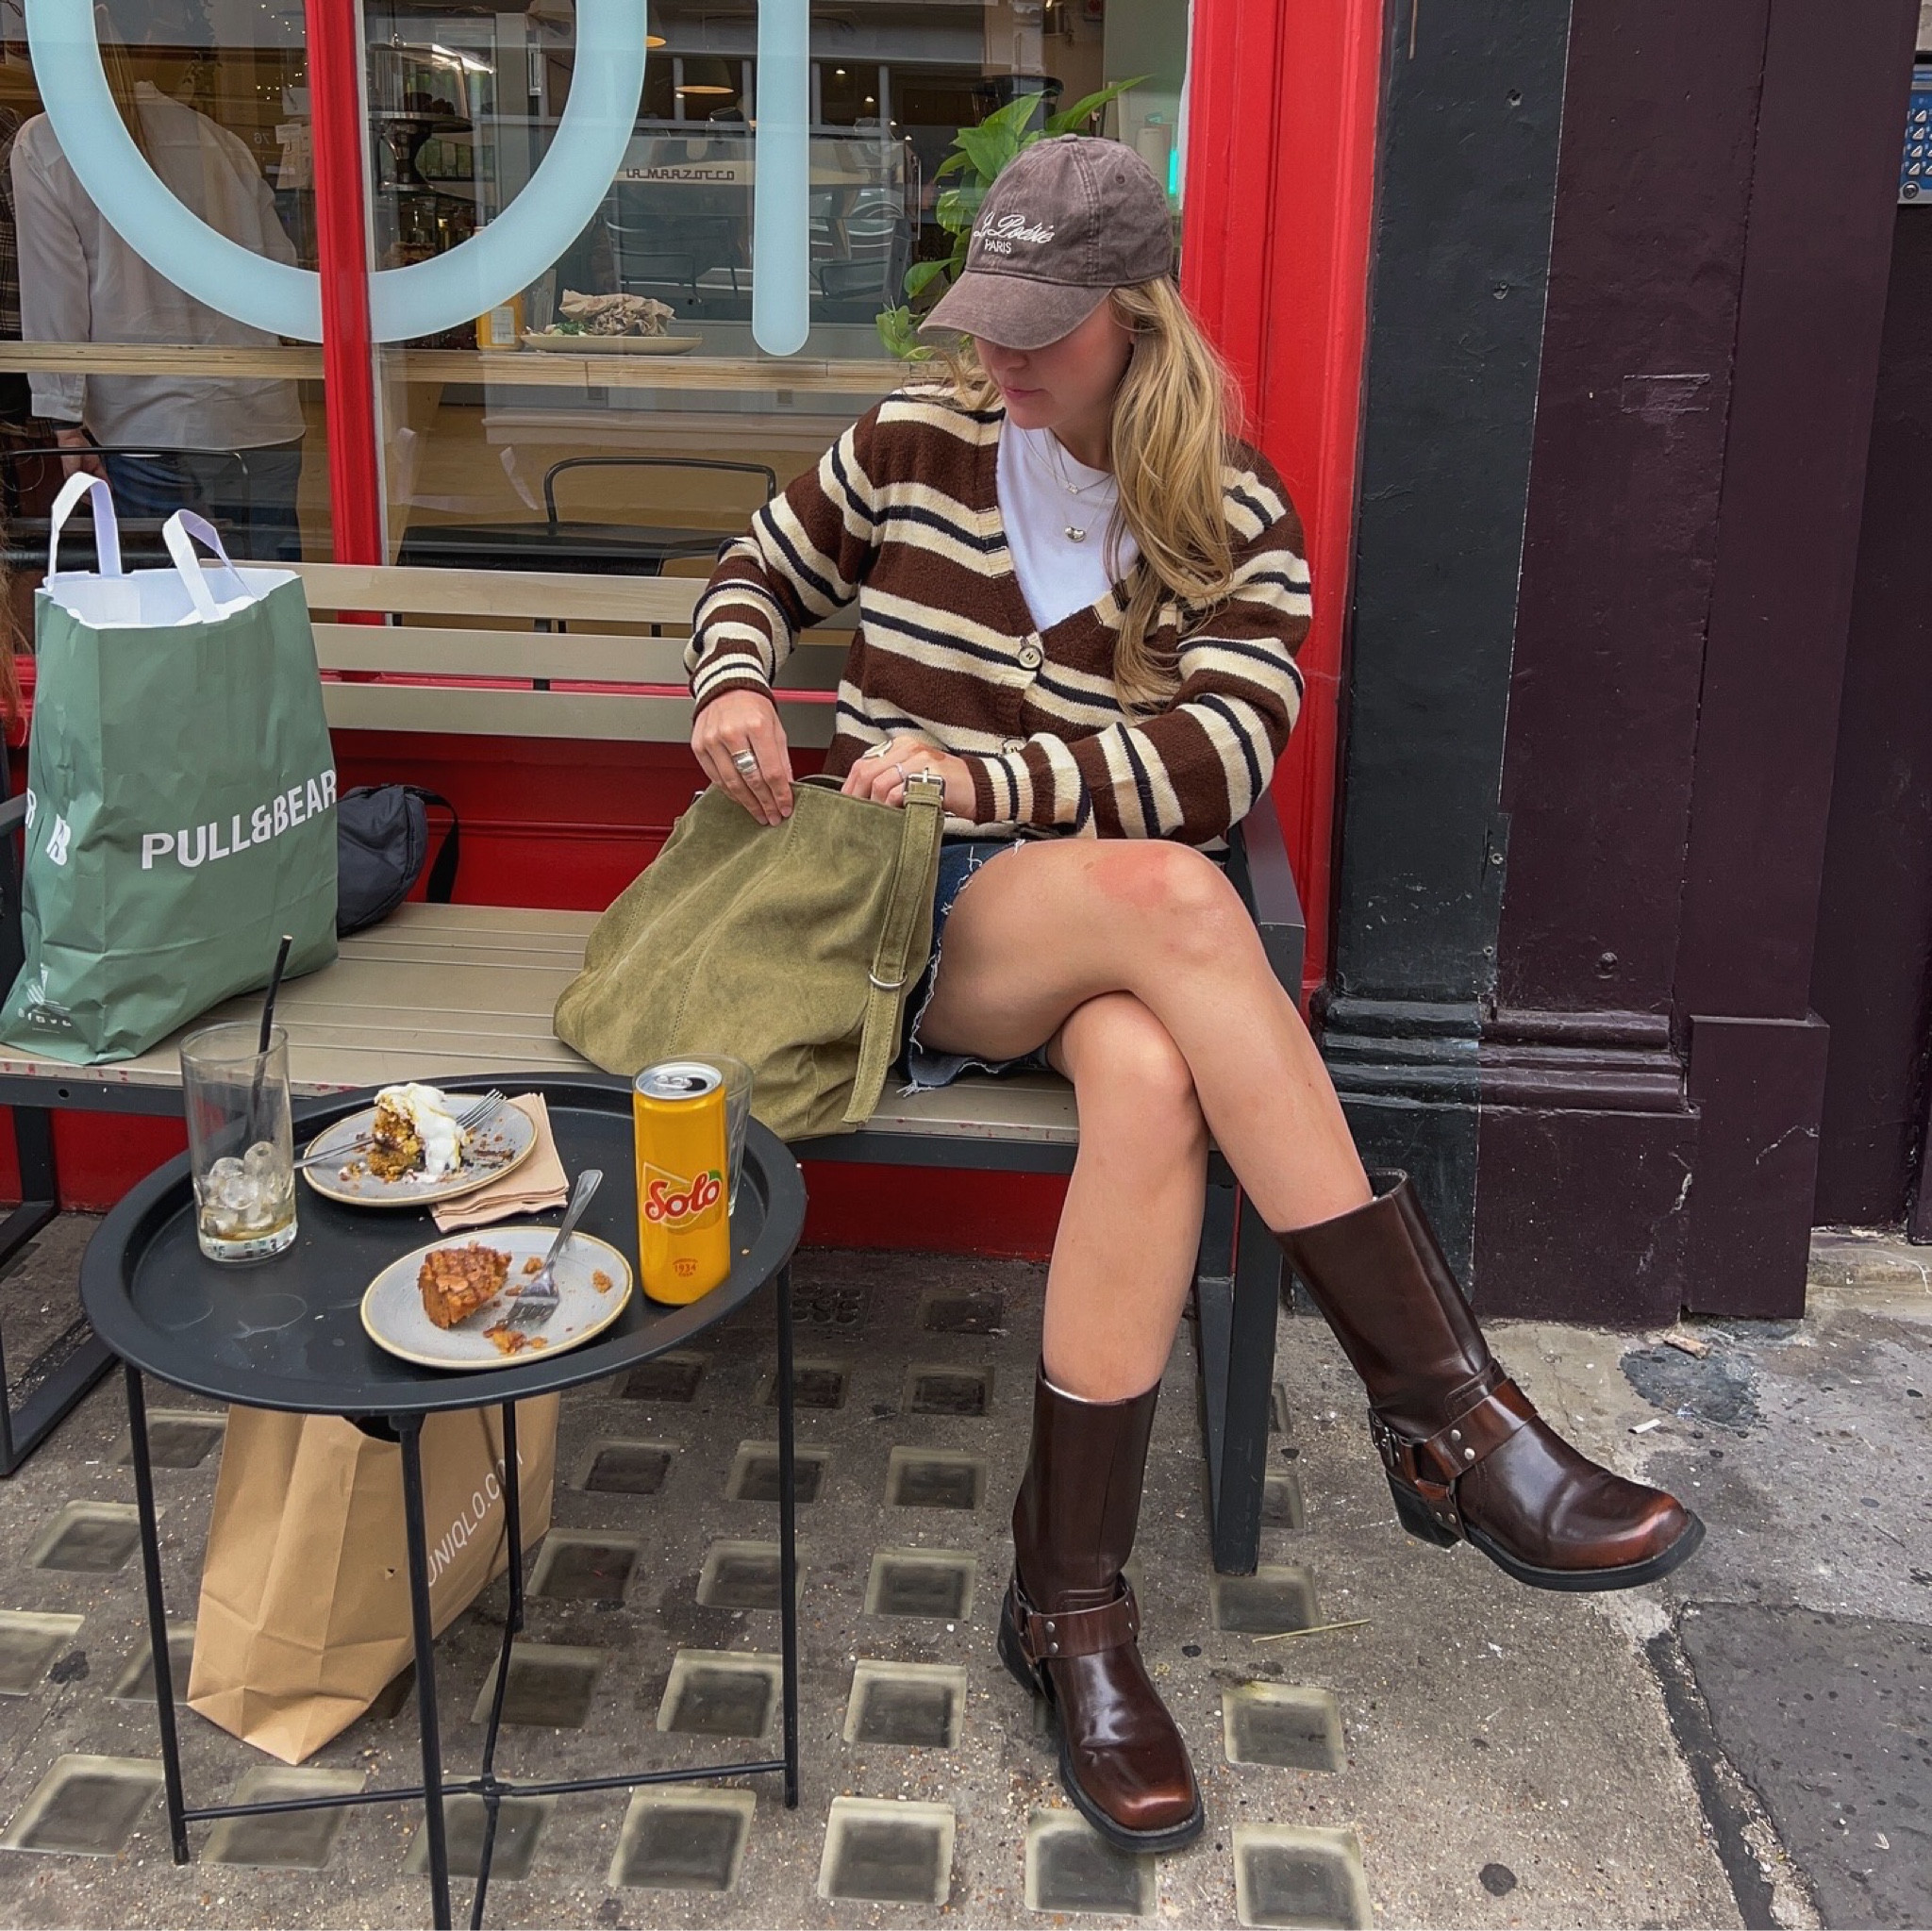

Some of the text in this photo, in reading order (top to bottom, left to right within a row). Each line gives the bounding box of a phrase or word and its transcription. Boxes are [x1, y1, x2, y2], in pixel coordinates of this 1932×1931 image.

[647, 168, 735, 181] MARZOCCO
[984, 238, 1012, 255] PARIS
[142, 769, 337, 870] PULL&BEAR
[643, 1172, 722, 1224] Solo
